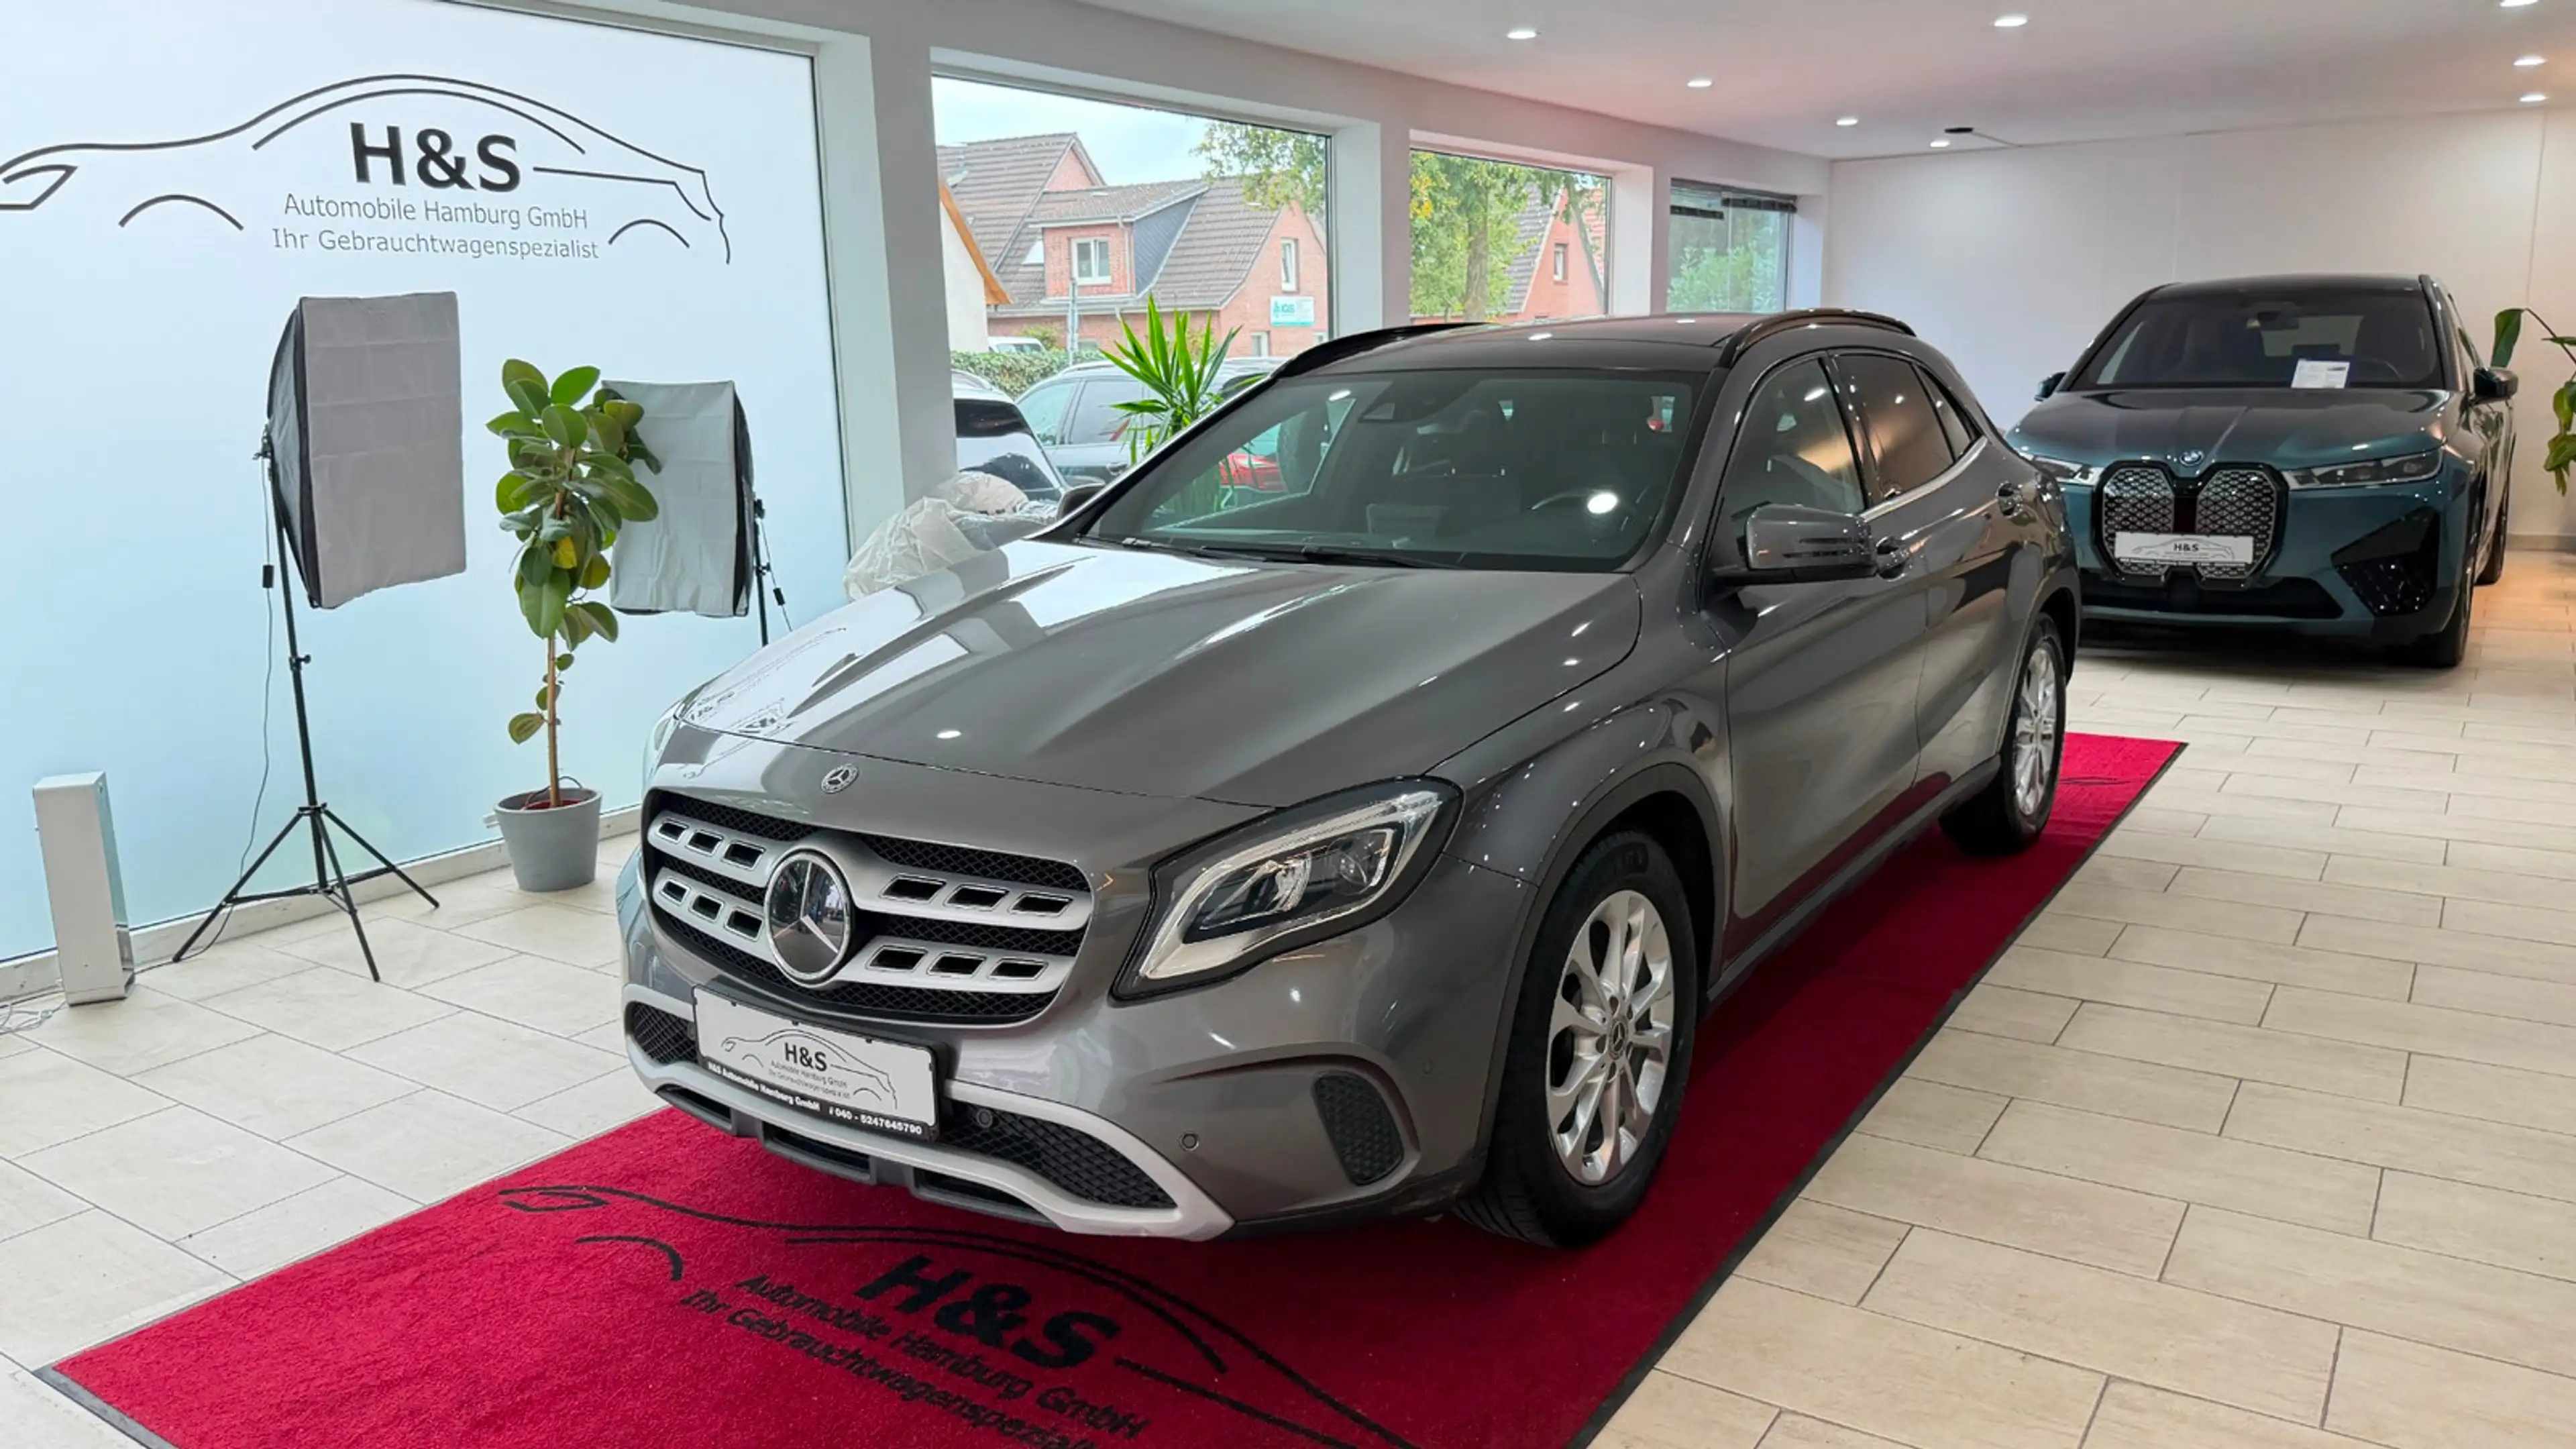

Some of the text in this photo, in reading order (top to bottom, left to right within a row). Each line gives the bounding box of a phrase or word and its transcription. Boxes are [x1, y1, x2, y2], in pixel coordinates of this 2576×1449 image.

[350, 122, 521, 193] H&S
[284, 193, 588, 229] Automobile Hamburg GmbH
[272, 228, 599, 260] Ihr Gebrauchtwagenspezialist
[784, 1042, 827, 1071] H&S
[722, 1067, 759, 1091] Automobile
[760, 1083, 795, 1105] Hamburg
[795, 1096, 820, 1111] GmbH
[680, 1289, 732, 1314] Ihr
[853, 1254, 1123, 1368] H&S
[734, 1274, 1151, 1440] Automobile Hamburg GmbH
